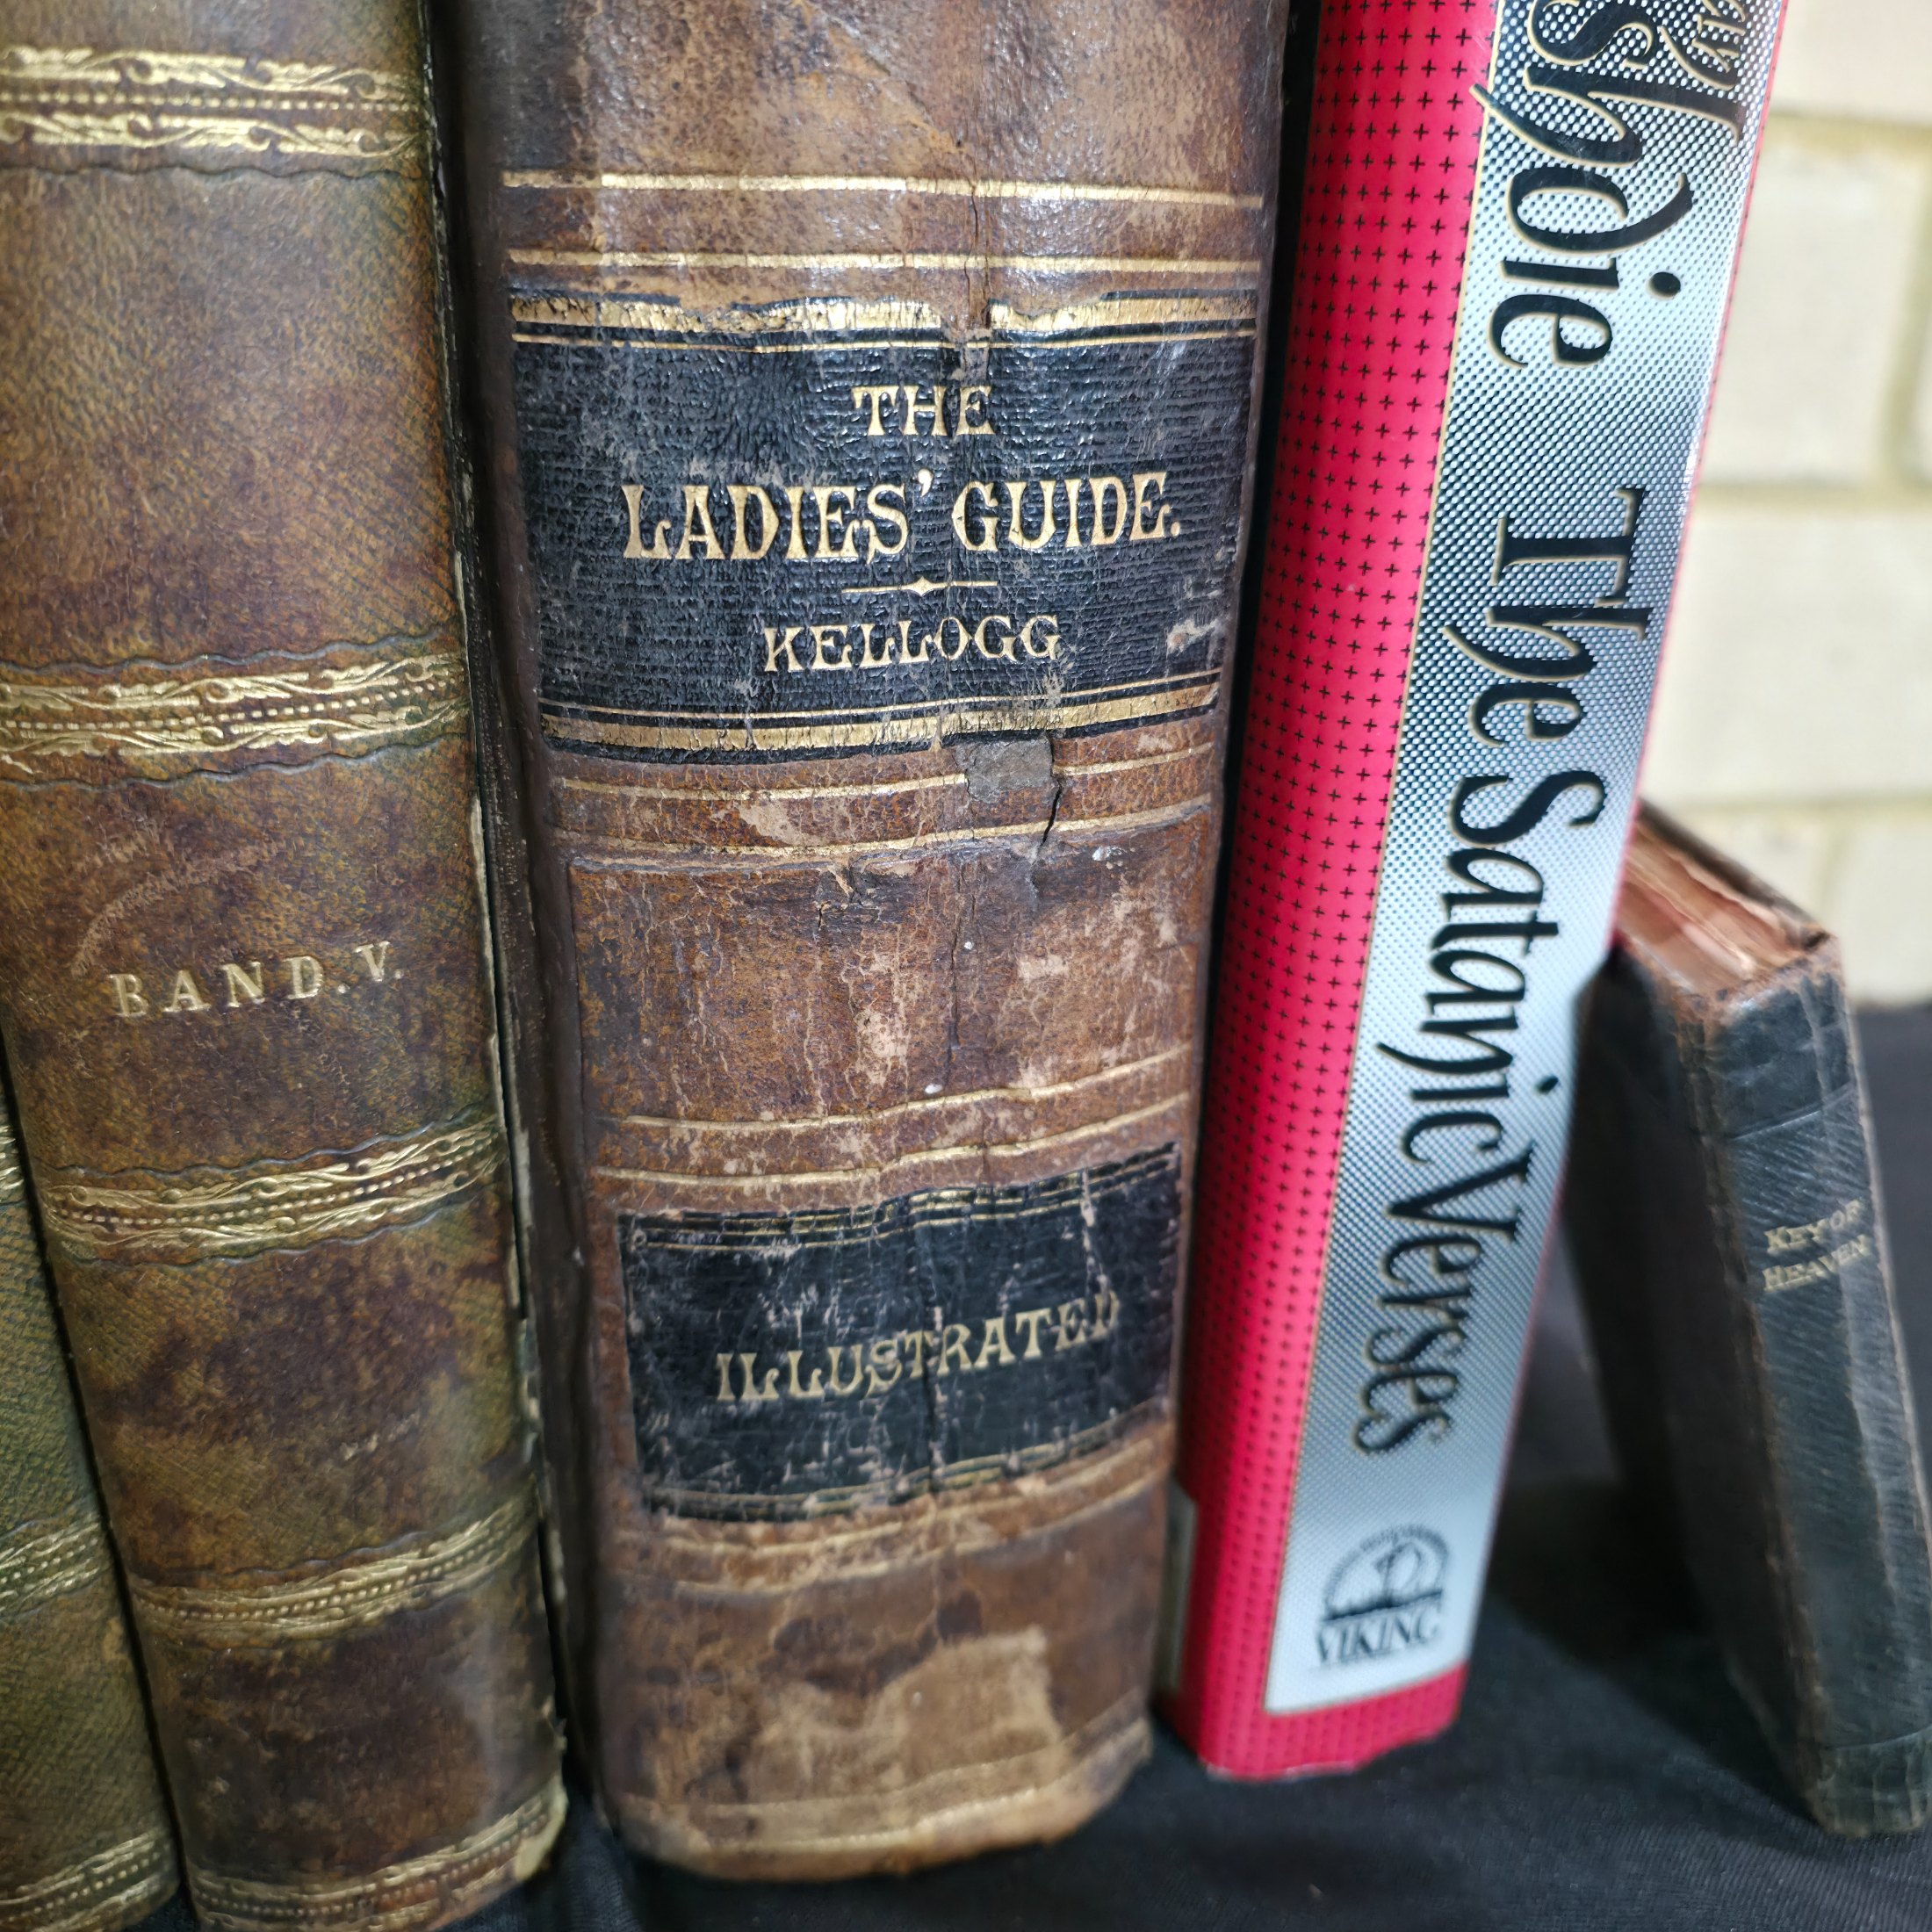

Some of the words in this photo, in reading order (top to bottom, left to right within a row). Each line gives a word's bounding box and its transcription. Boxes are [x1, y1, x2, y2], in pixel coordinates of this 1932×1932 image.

[852, 384, 996, 436] THE
[621, 468, 935, 565] LADIES'
[951, 470, 1183, 553] GUIDE.
[763, 616, 1061, 674] KELLOGG
[1442, 485, 1654, 747] The
[1375, 769, 1607, 1164] Satanic
[1352, 1141, 1535, 1457] Verses
[1762, 1233, 1873, 1293] HEAVEN
[715, 1289, 1121, 1402] ILLUSTRATED
[1316, 1604, 1445, 1663] VIKING
